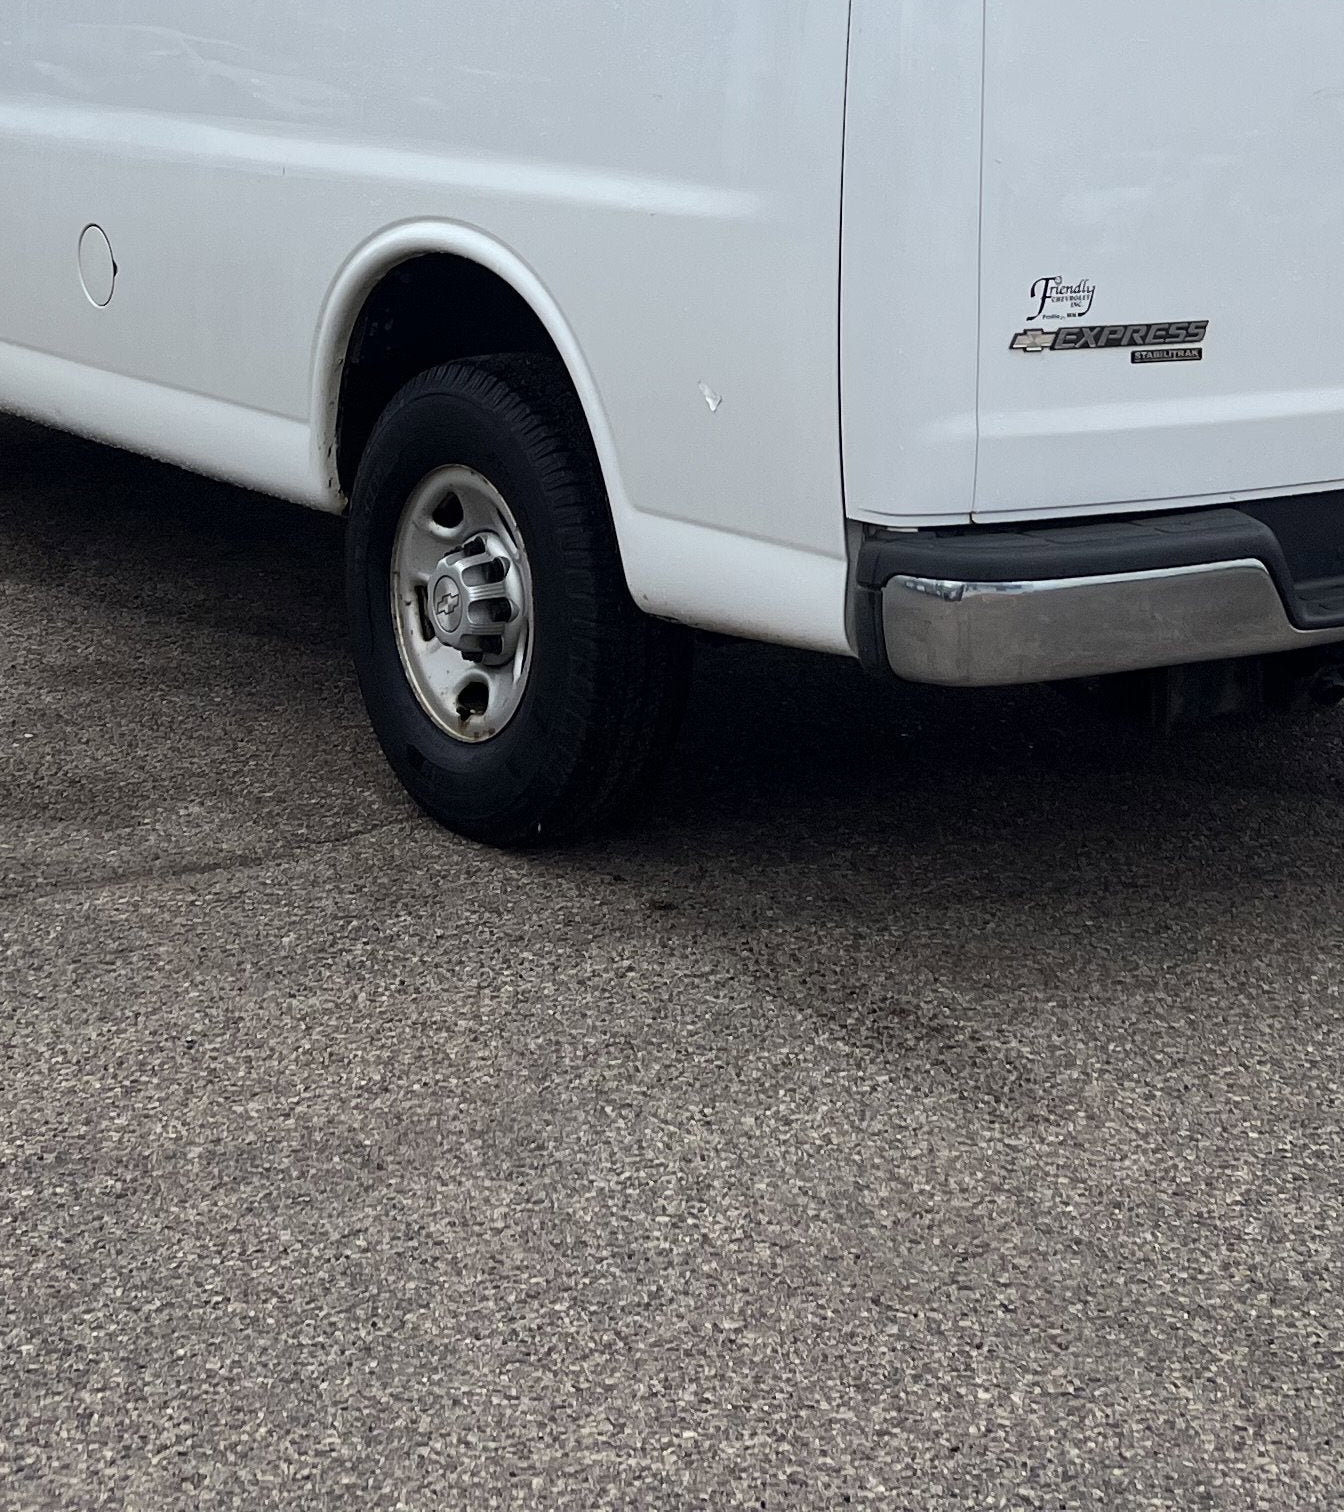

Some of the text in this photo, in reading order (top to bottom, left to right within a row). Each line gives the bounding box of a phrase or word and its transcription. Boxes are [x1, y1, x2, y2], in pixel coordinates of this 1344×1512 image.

[1026, 275, 1096, 322] Friendly
[1054, 321, 1208, 350] EXPRESS
[1134, 349, 1200, 362] STABILITRAK
